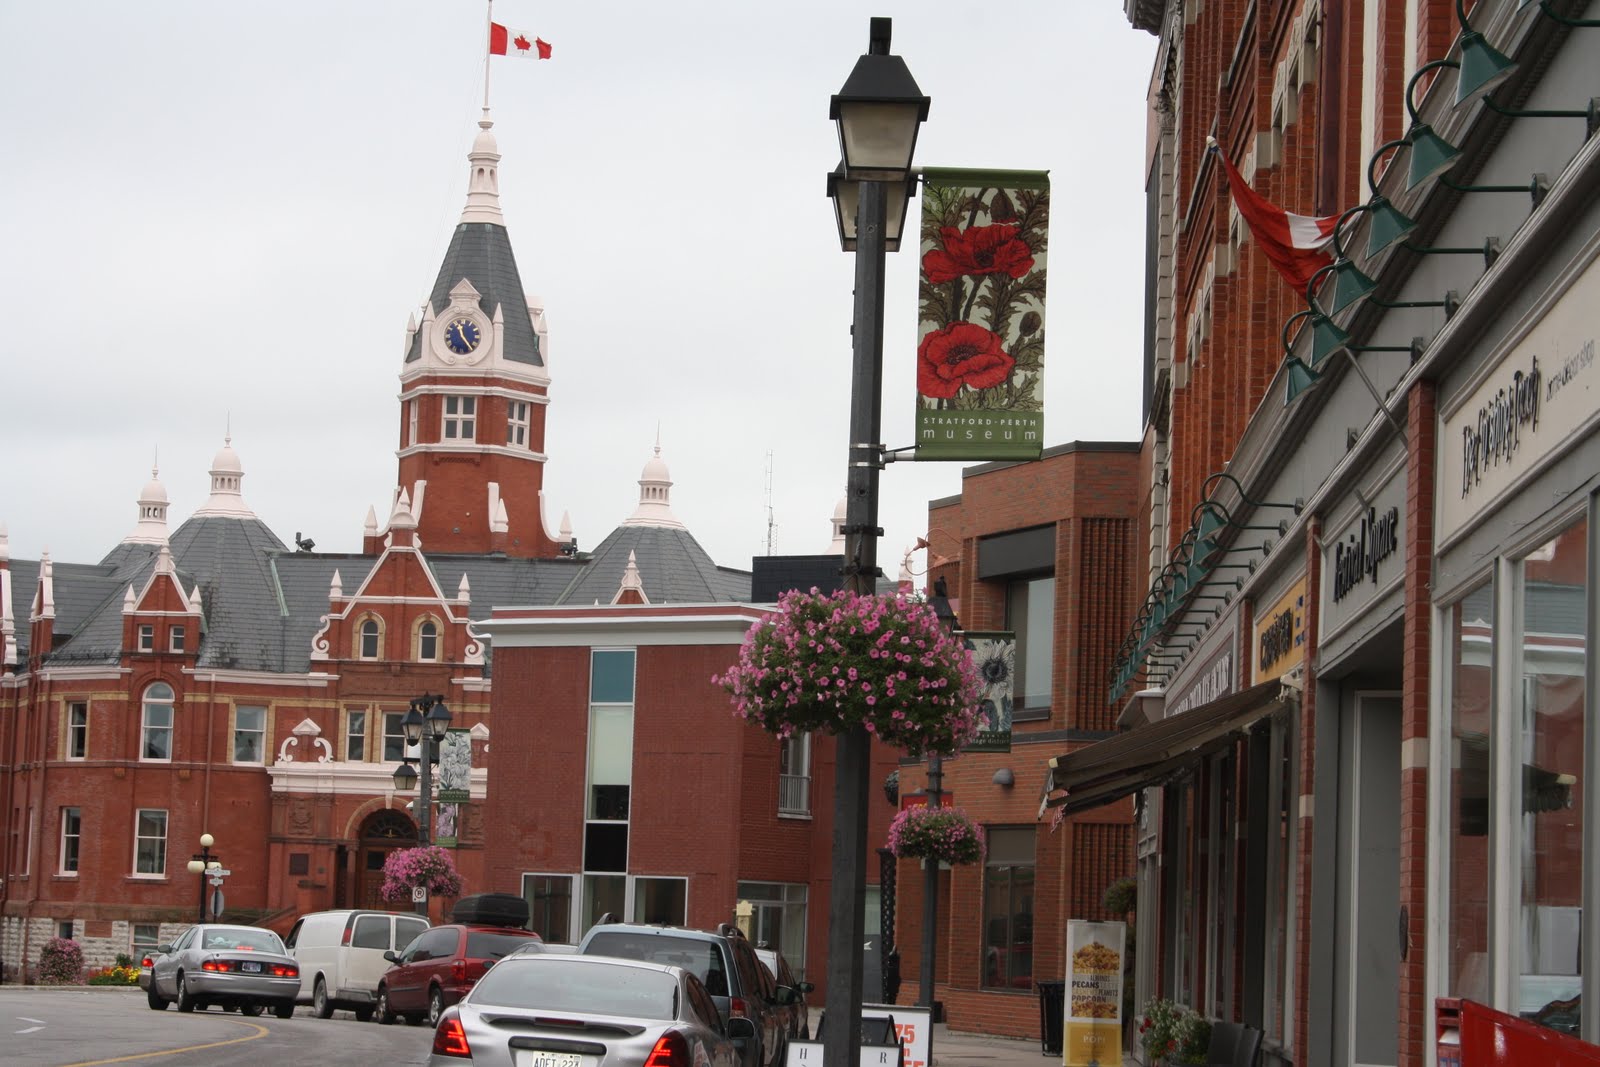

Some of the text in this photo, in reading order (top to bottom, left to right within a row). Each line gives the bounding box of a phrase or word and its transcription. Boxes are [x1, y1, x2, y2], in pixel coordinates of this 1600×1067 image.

[923, 428, 1036, 440] museum
[1462, 425, 1476, 499] The
[1513, 355, 1539, 450] Touch
[1365, 507, 1398, 584] Square
[1072, 980, 1100, 989] PECANS
